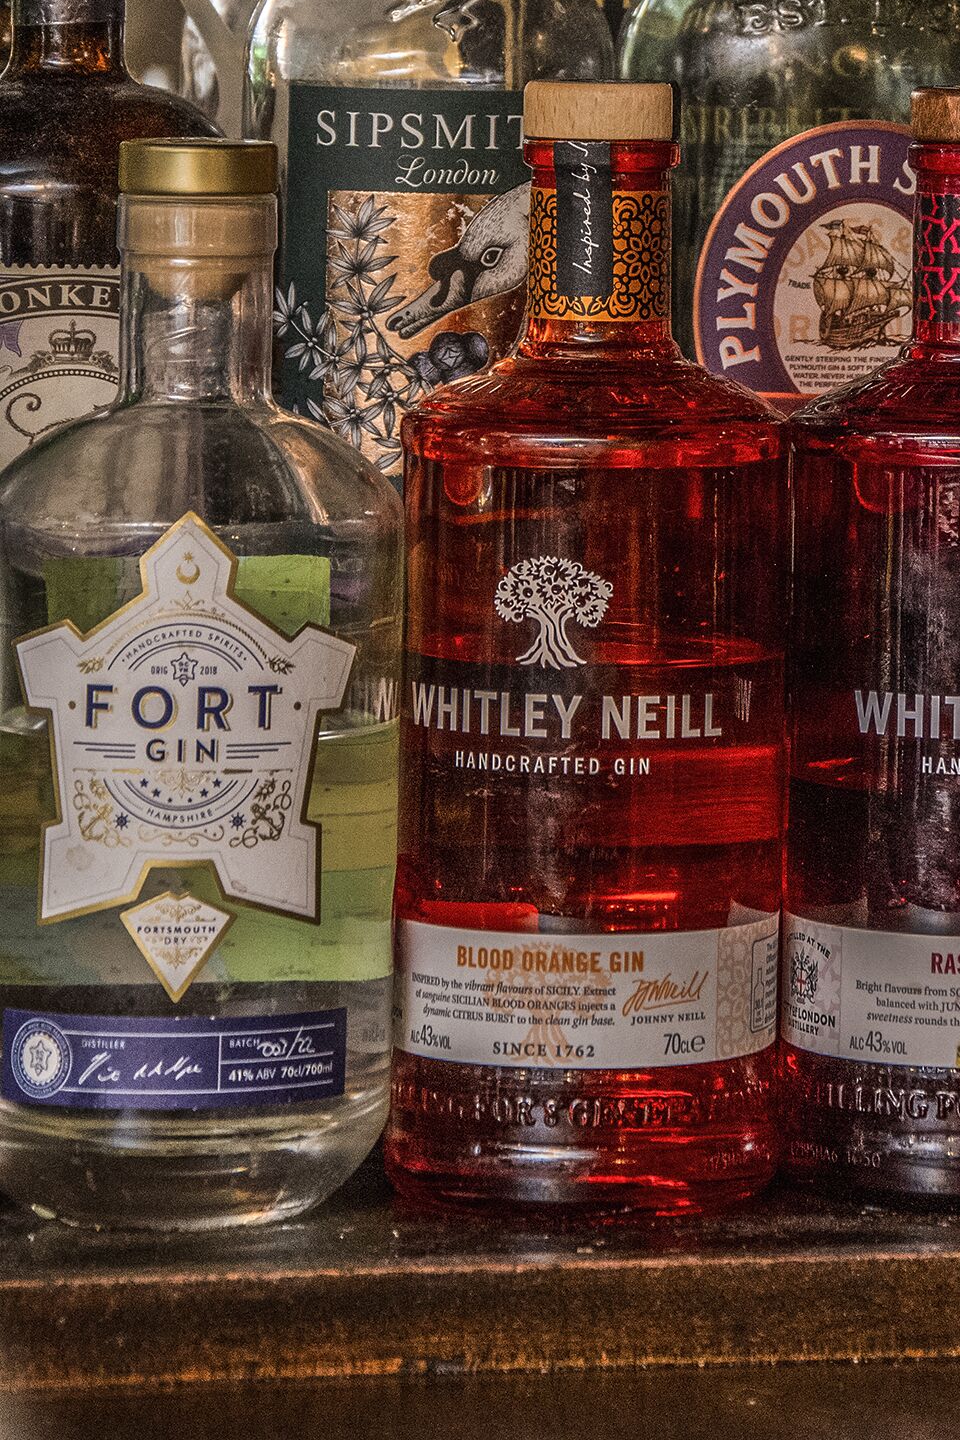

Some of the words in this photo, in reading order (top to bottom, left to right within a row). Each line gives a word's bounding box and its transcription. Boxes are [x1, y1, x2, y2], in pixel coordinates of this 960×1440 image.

[315, 110, 524, 151] SIPSMIT
[395, 156, 500, 188] London
[572, 163, 597, 181] by
[573, 189, 600, 275] Inspired
[716, 145, 882, 370] PLYMOUTH
[0, 284, 119, 313] ONKE
[126, 629, 202, 660] HANDCRAFTED
[207, 633, 245, 659] SPIRITS
[151, 665, 168, 675] ORIG
[200, 665, 218, 675] 2018
[84, 684, 283, 732] FORT
[412, 681, 582, 739] WHITLEY
[602, 693, 722, 740] NEILL
[145, 738, 219, 763] GIN
[455, 750, 600, 776] HANDCRAFTED
[614, 758, 651, 776] GIN
[146, 807, 214, 824] HAMPSHIRE
[136, 926, 216, 935] PORTSMOUTH
[164, 937, 187, 945] DRY
[457, 945, 514, 970] BLOOD
[521, 951, 601, 973] ORANGE
[609, 950, 645, 973] GIN
[412, 972, 441, 986] INSPIRED
[451, 979, 462, 989] the
[464, 979, 494, 993] vibrant
[495, 982, 533, 996] flavours
[534, 985, 545, 995] of
[583, 986, 616, 997] Extract
[855, 979, 882, 995] Bright
[884, 983, 923, 996] flavours
[924, 986, 948, 997] from
[422, 990, 451, 1003] sanguine
[452, 994, 490, 1007] SICILIAN
[492, 997, 525, 1009] BLOOD
[527, 998, 576, 1010] ORANGES
[578, 1001, 608, 1012] injects
[876, 997, 916, 1010] balanced
[918, 1001, 939, 1011] with
[423, 1004, 451, 1018] dynamic
[452, 1009, 484, 1021] CITRUS
[485, 1011, 515, 1024] BURST
[528, 1014, 543, 1025] the
[545, 1014, 570, 1025] clean
[572, 1016, 588, 1028] gin
[590, 1014, 615, 1026] base.
[631, 1013, 674, 1026] JOHNNY
[677, 1011, 706, 1021] NEILL
[798, 1009, 837, 1028] LONDON
[866, 1011, 913, 1024] sweetness
[914, 1016, 948, 1027] rounds
[81, 1040, 126, 1050] DISTILLER
[229, 1038, 260, 1049] BATCH
[493, 1041, 547, 1057] SINCE
[555, 1044, 595, 1057] 1762
[228, 1068, 254, 1082] 41%
[256, 1067, 277, 1080] ABV
